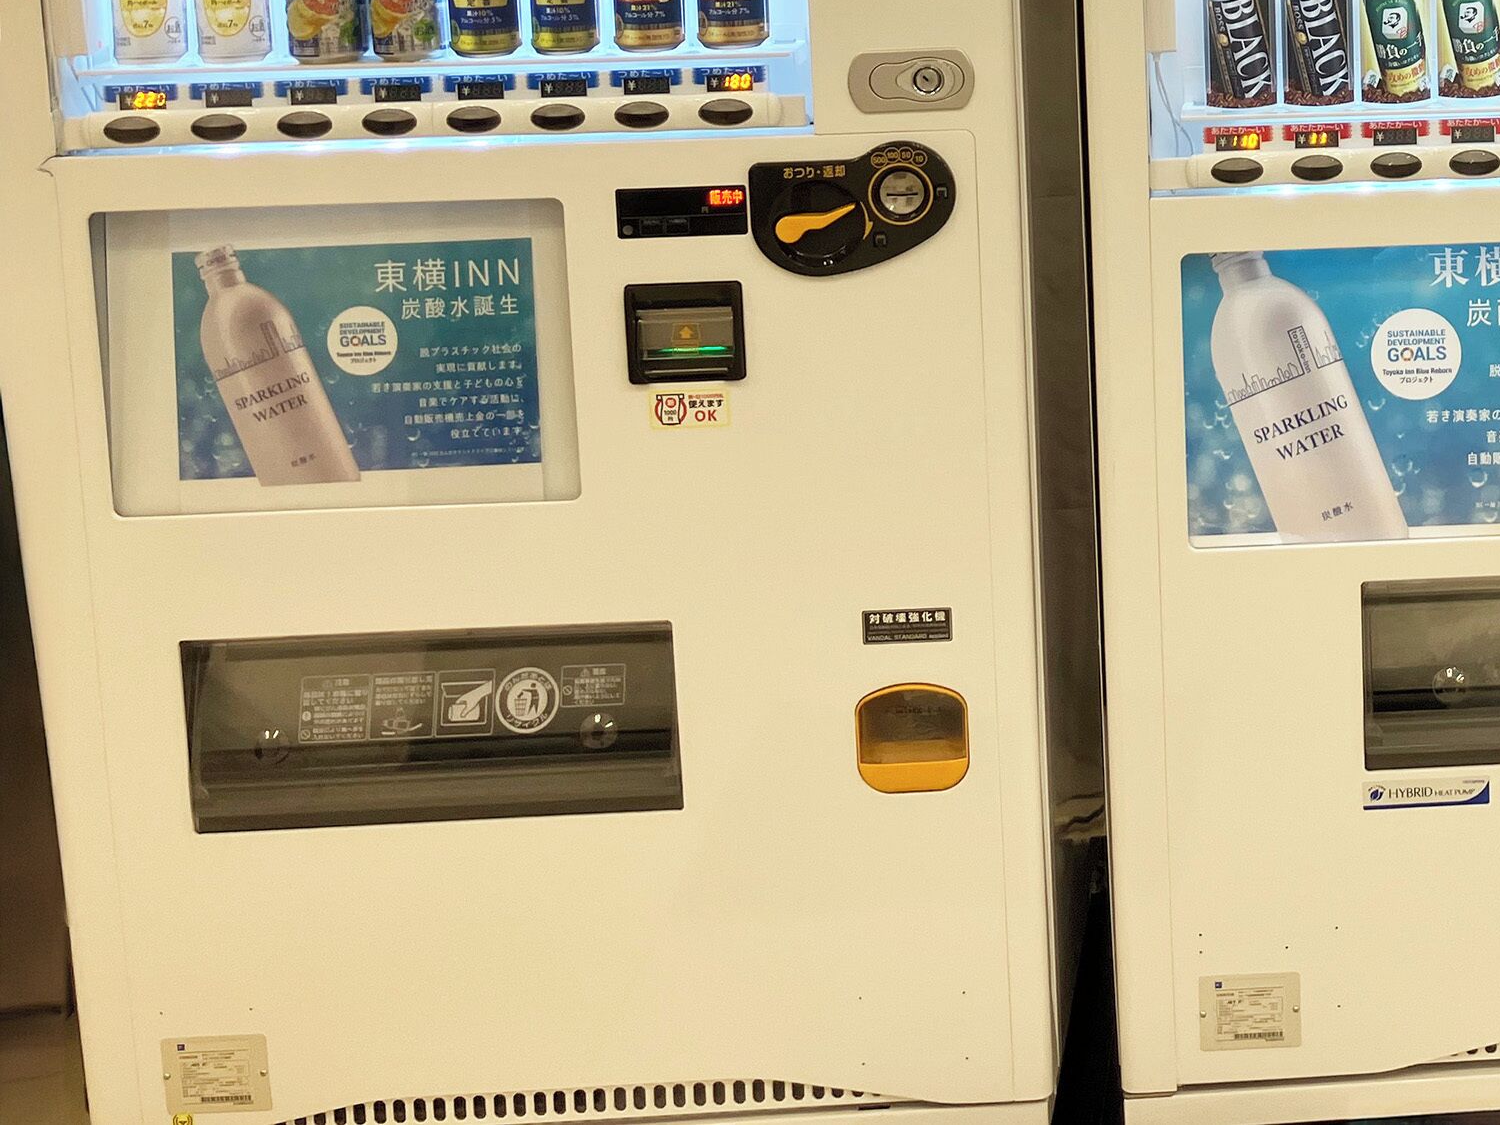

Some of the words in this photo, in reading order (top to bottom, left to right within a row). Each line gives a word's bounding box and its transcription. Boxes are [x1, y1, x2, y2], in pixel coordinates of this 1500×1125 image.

[134, 92, 166, 108] 220
[873, 156, 886, 164] 500
[783, 166, 846, 179] おつり・返却
[709, 189, 743, 205] 販売中
[374, 258, 520, 293] 東横INN
[401, 294, 519, 320] 炭酸水誕生
[339, 333, 387, 348] GOALS
[1387, 329, 1445, 338] SUSTAINABLE
[1387, 338, 1445, 346] DEVELOPMENT
[419, 344, 521, 358] 脱プラスチック社会の
[1388, 346, 1446, 362] GOALS
[235, 372, 310, 410] SPARKLING
[252, 393, 308, 425] WATER
[689, 400, 723, 408] 使えます
[695, 410, 716, 422] OK
[1252, 393, 1348, 444] SPARKLING
[1275, 422, 1345, 461] WATER
[1321, 501, 1354, 521] 炭酸水
[1389, 786, 1433, 799] HYBRID
